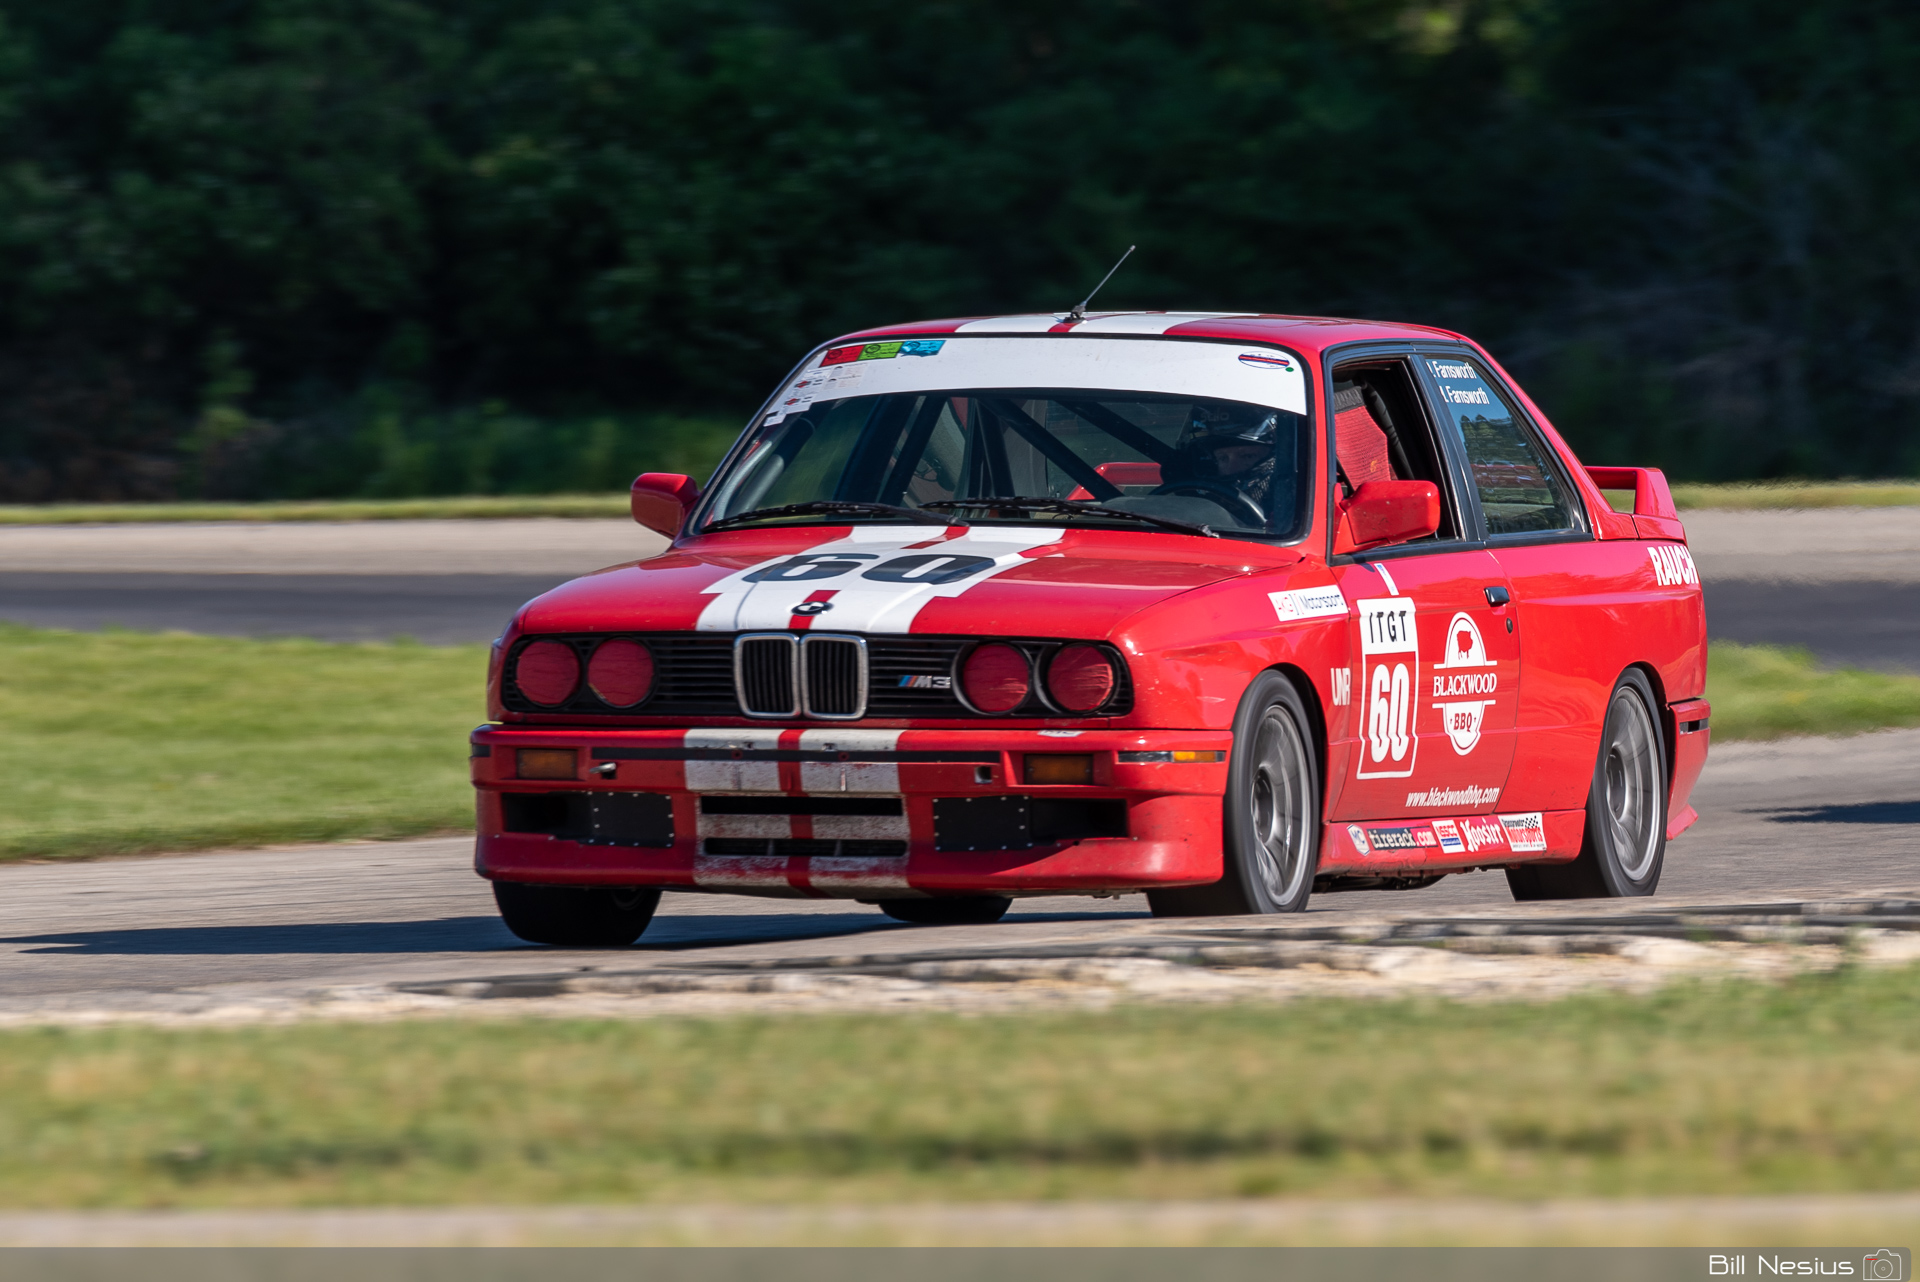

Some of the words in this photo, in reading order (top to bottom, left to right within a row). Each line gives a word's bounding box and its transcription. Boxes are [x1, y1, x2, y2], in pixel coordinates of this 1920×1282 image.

[741, 553, 996, 585] 60
[1646, 545, 1699, 586] RAUCH
[1369, 610, 1407, 643] ITGT
[912, 675, 951, 689] M3
[1433, 673, 1498, 697] BLACKWOOD
[1368, 663, 1410, 763] 60
[1453, 712, 1473, 733] BBQ
[1405, 784, 1500, 808] www.blackwoodbbq.com
[1367, 829, 1437, 848] tirerack.com
